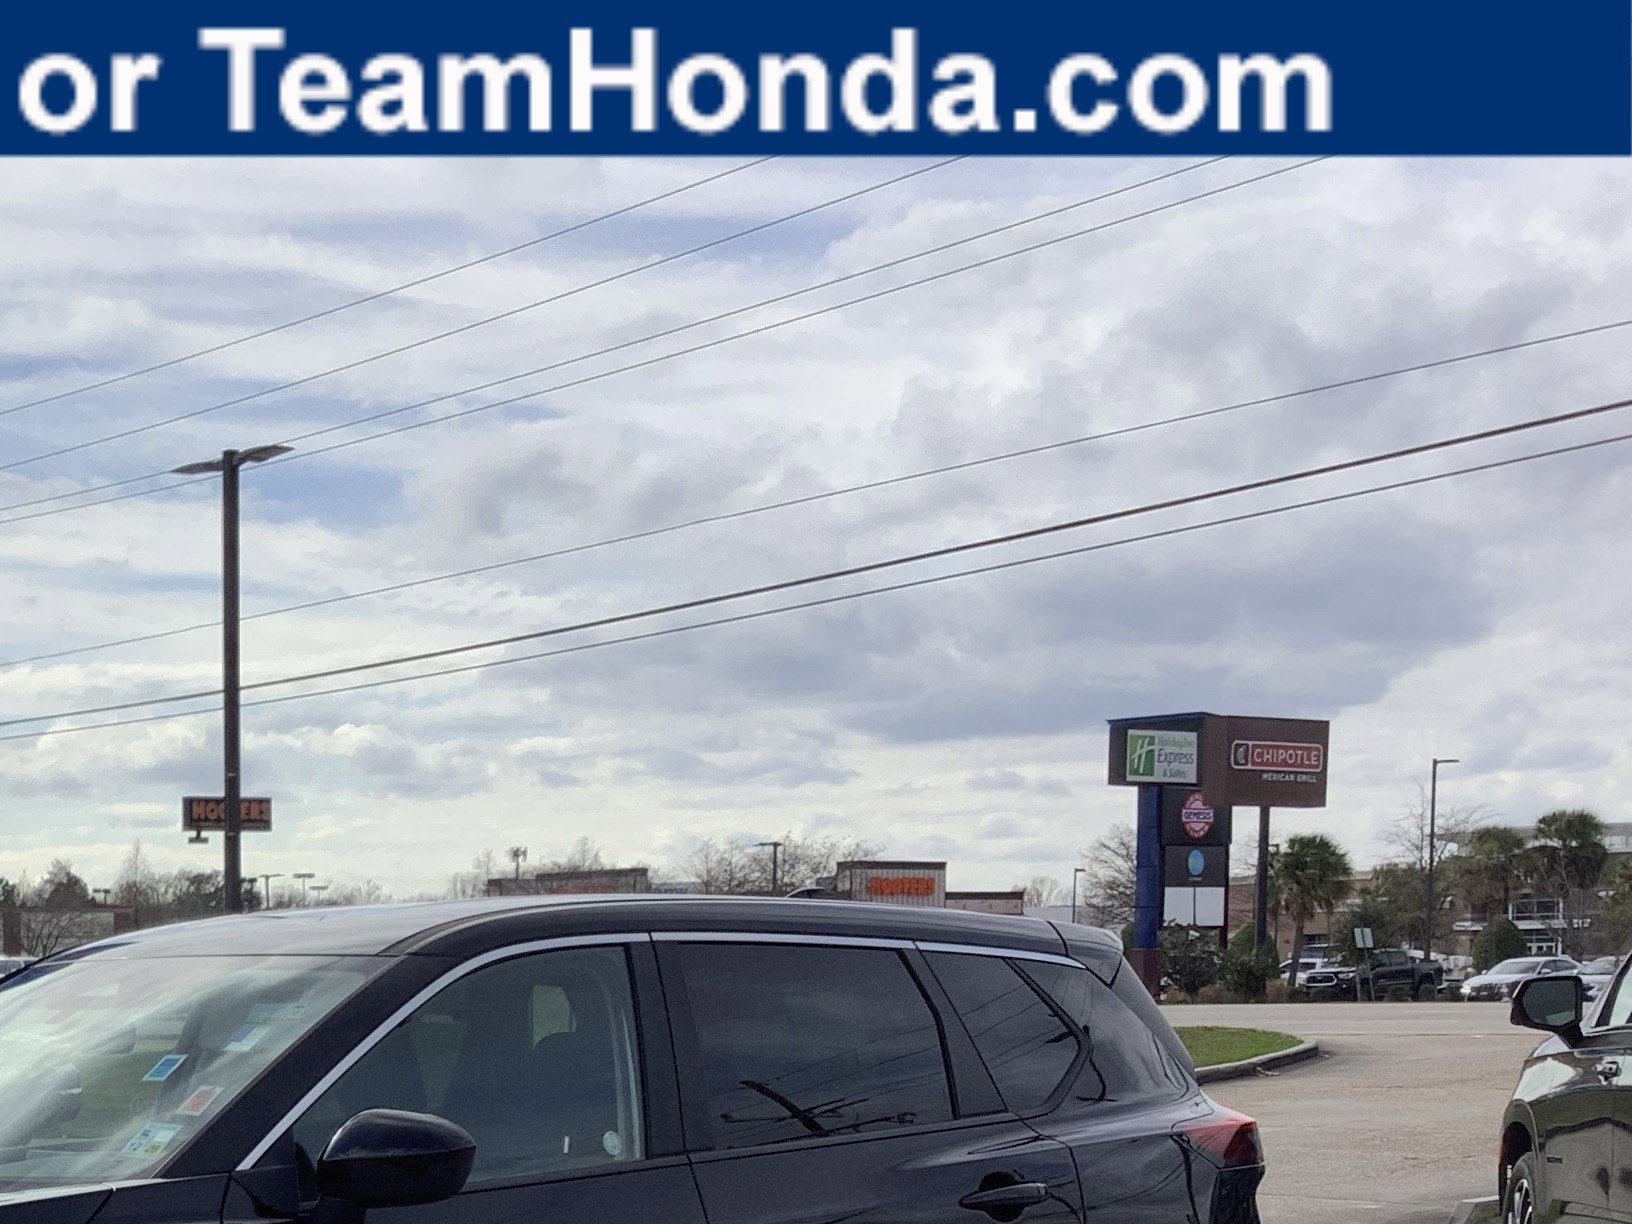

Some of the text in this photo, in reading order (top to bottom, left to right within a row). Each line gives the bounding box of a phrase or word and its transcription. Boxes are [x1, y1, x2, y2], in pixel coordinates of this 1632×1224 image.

[1157, 748, 1194, 766] Express
[1253, 748, 1319, 765] CHIPOTLE
[1262, 773, 1317, 783] MEXICAN GRILL
